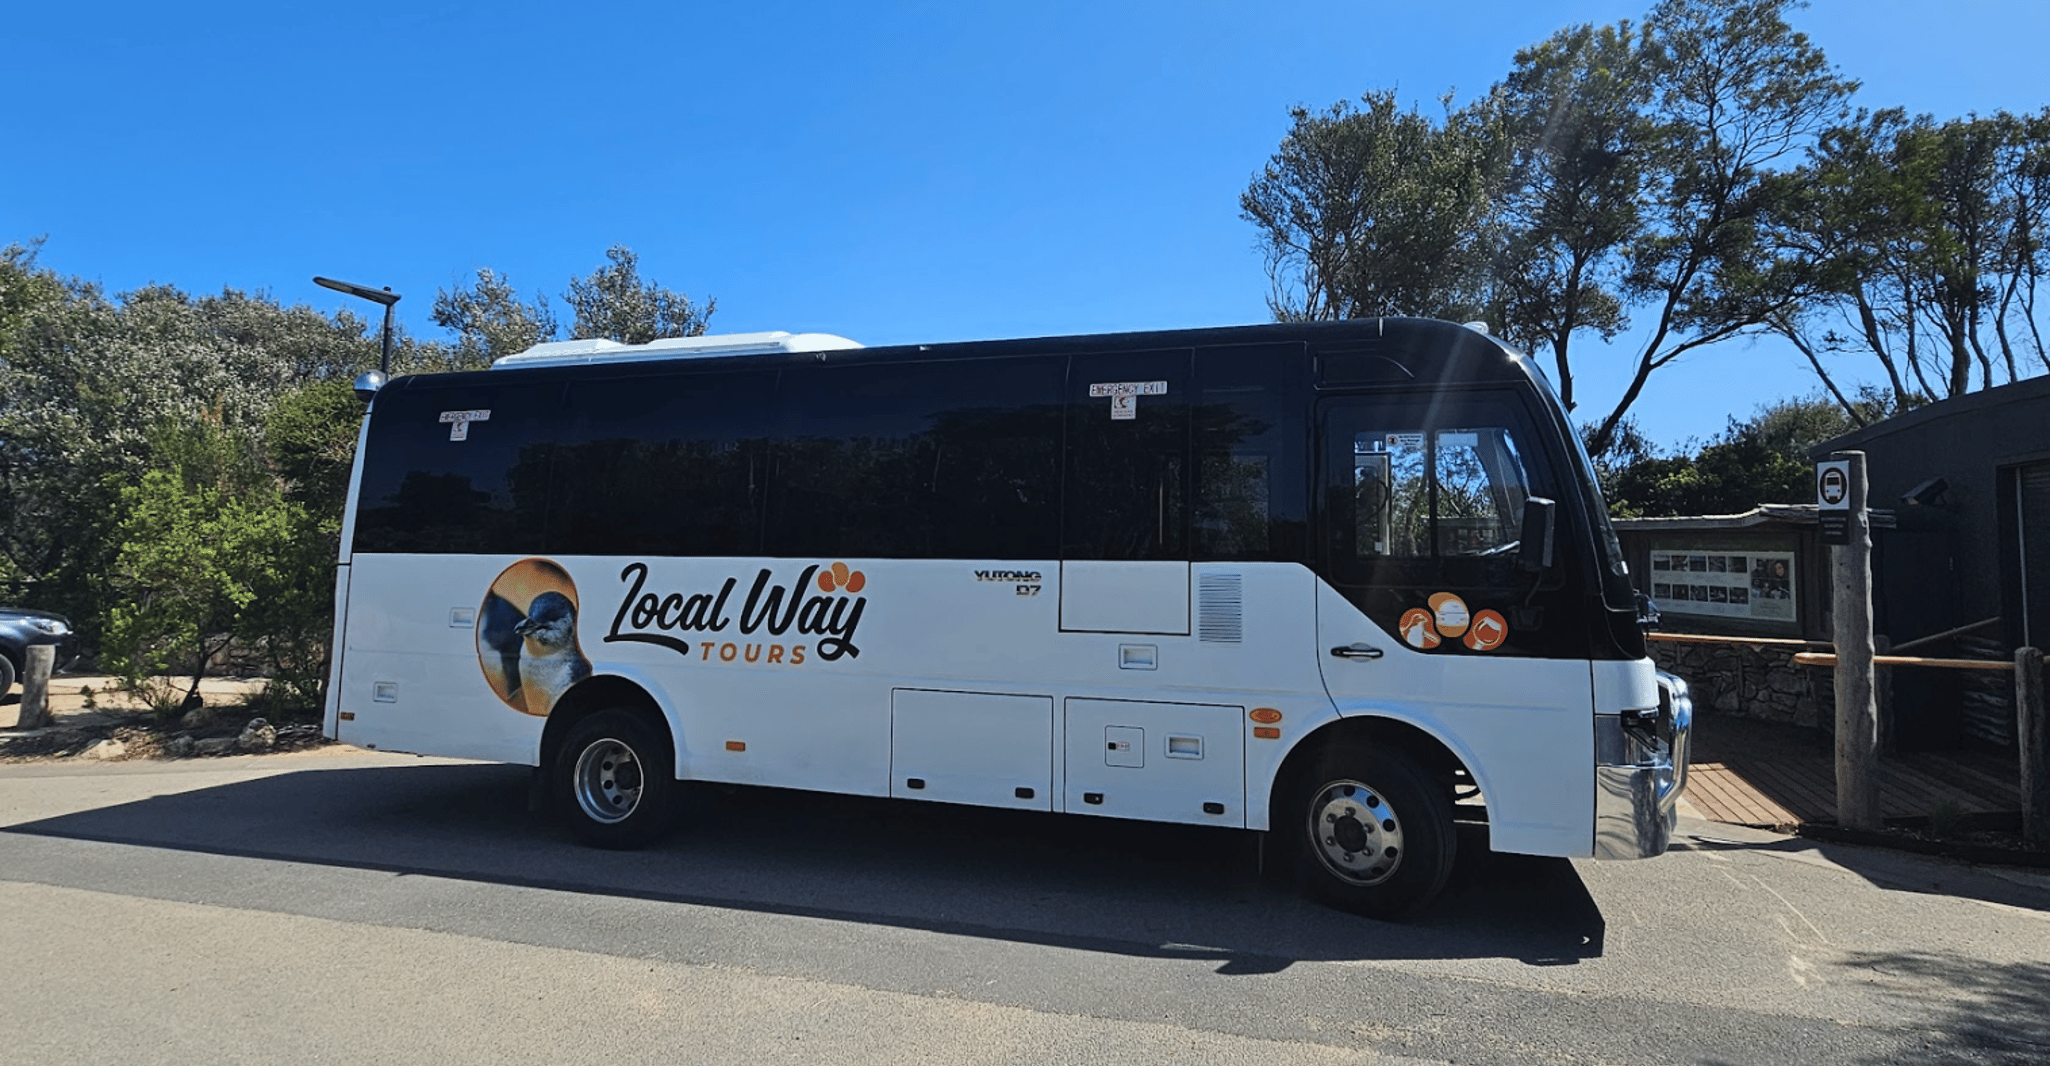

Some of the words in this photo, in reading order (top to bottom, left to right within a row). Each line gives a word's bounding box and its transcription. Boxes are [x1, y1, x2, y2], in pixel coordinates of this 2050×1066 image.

[1091, 383, 1138, 395] EMERGENCY
[1143, 382, 1165, 394] EXIT
[974, 570, 1042, 582] YUTONG
[1016, 585, 1042, 596] D7
[603, 562, 737, 656] Local
[740, 564, 867, 661] Way
[701, 642, 807, 665] TOURS
